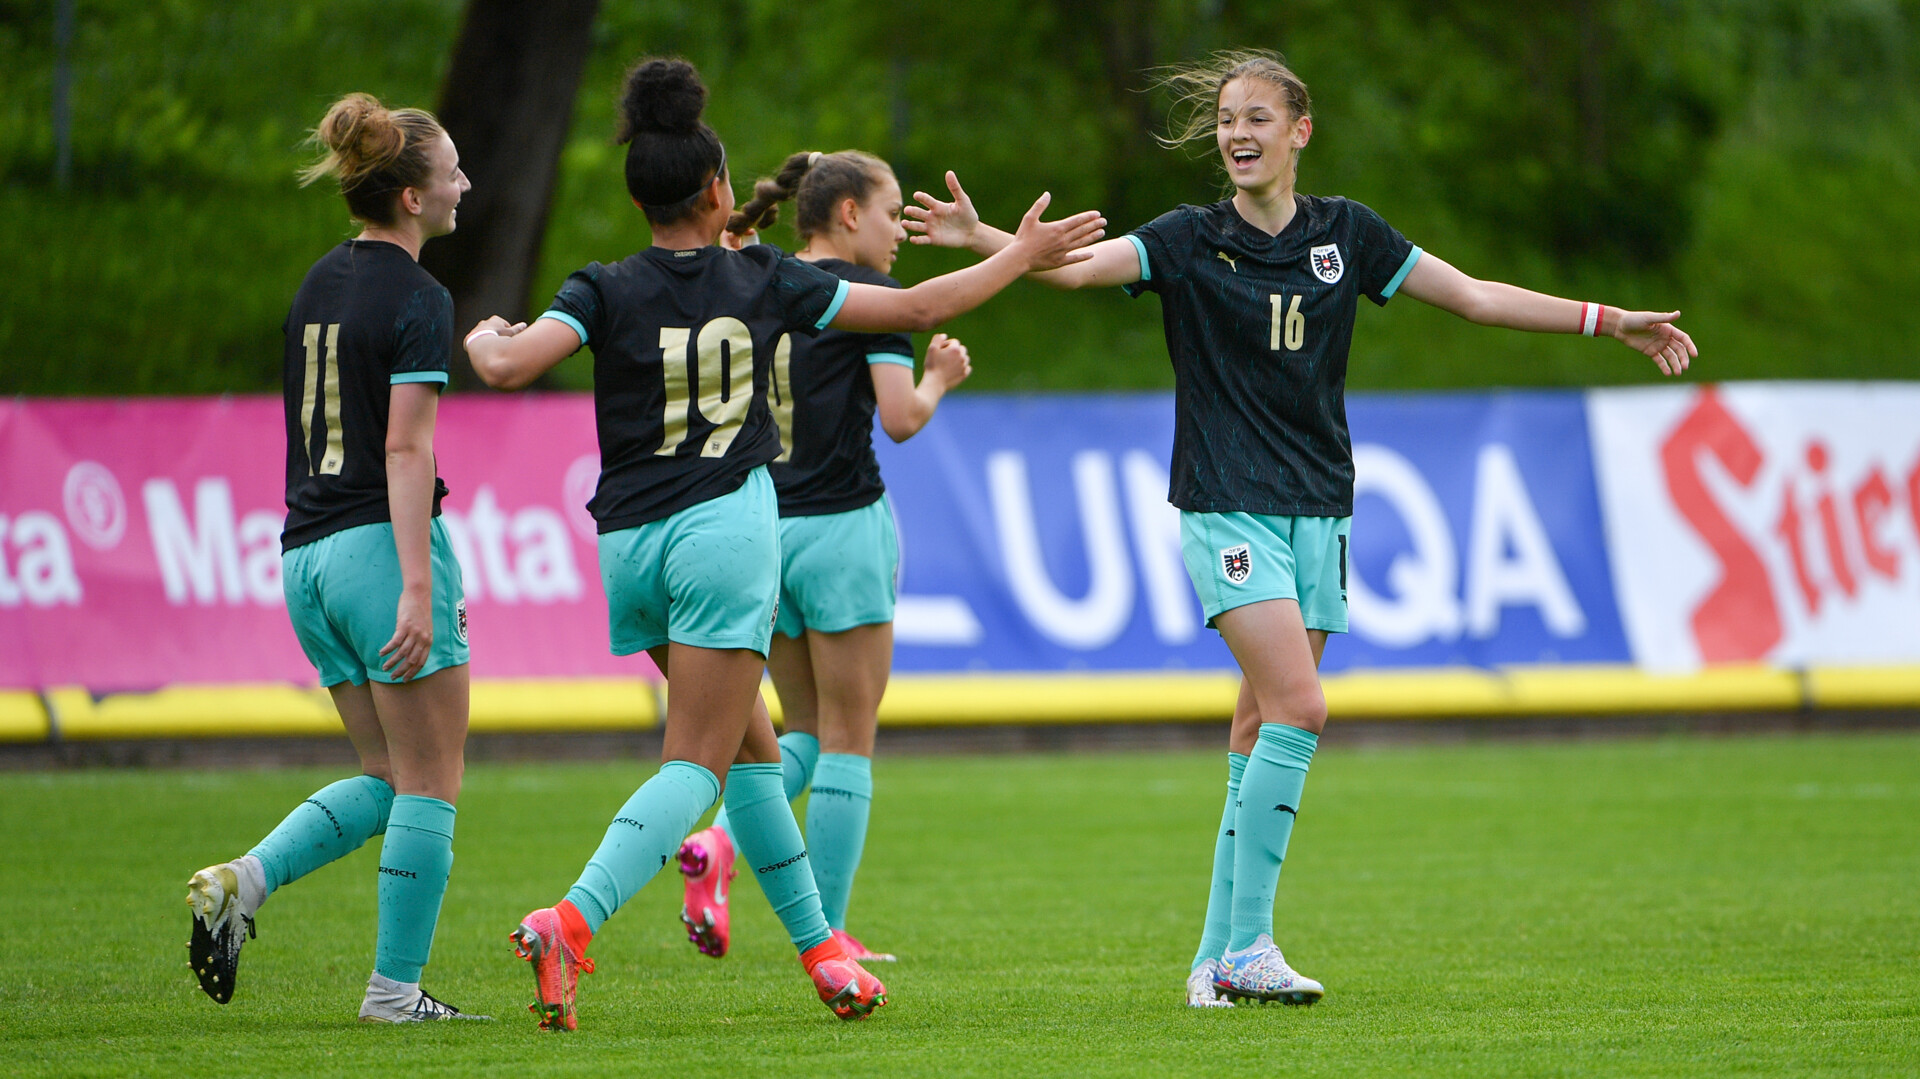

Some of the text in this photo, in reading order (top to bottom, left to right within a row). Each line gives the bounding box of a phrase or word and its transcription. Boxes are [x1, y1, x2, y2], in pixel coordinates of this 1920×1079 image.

[653, 316, 754, 459] 19
[1269, 294, 1306, 351] 16
[302, 323, 344, 477] 11
[987, 442, 1588, 650] UNQA
[1660, 384, 1920, 669] Stie
